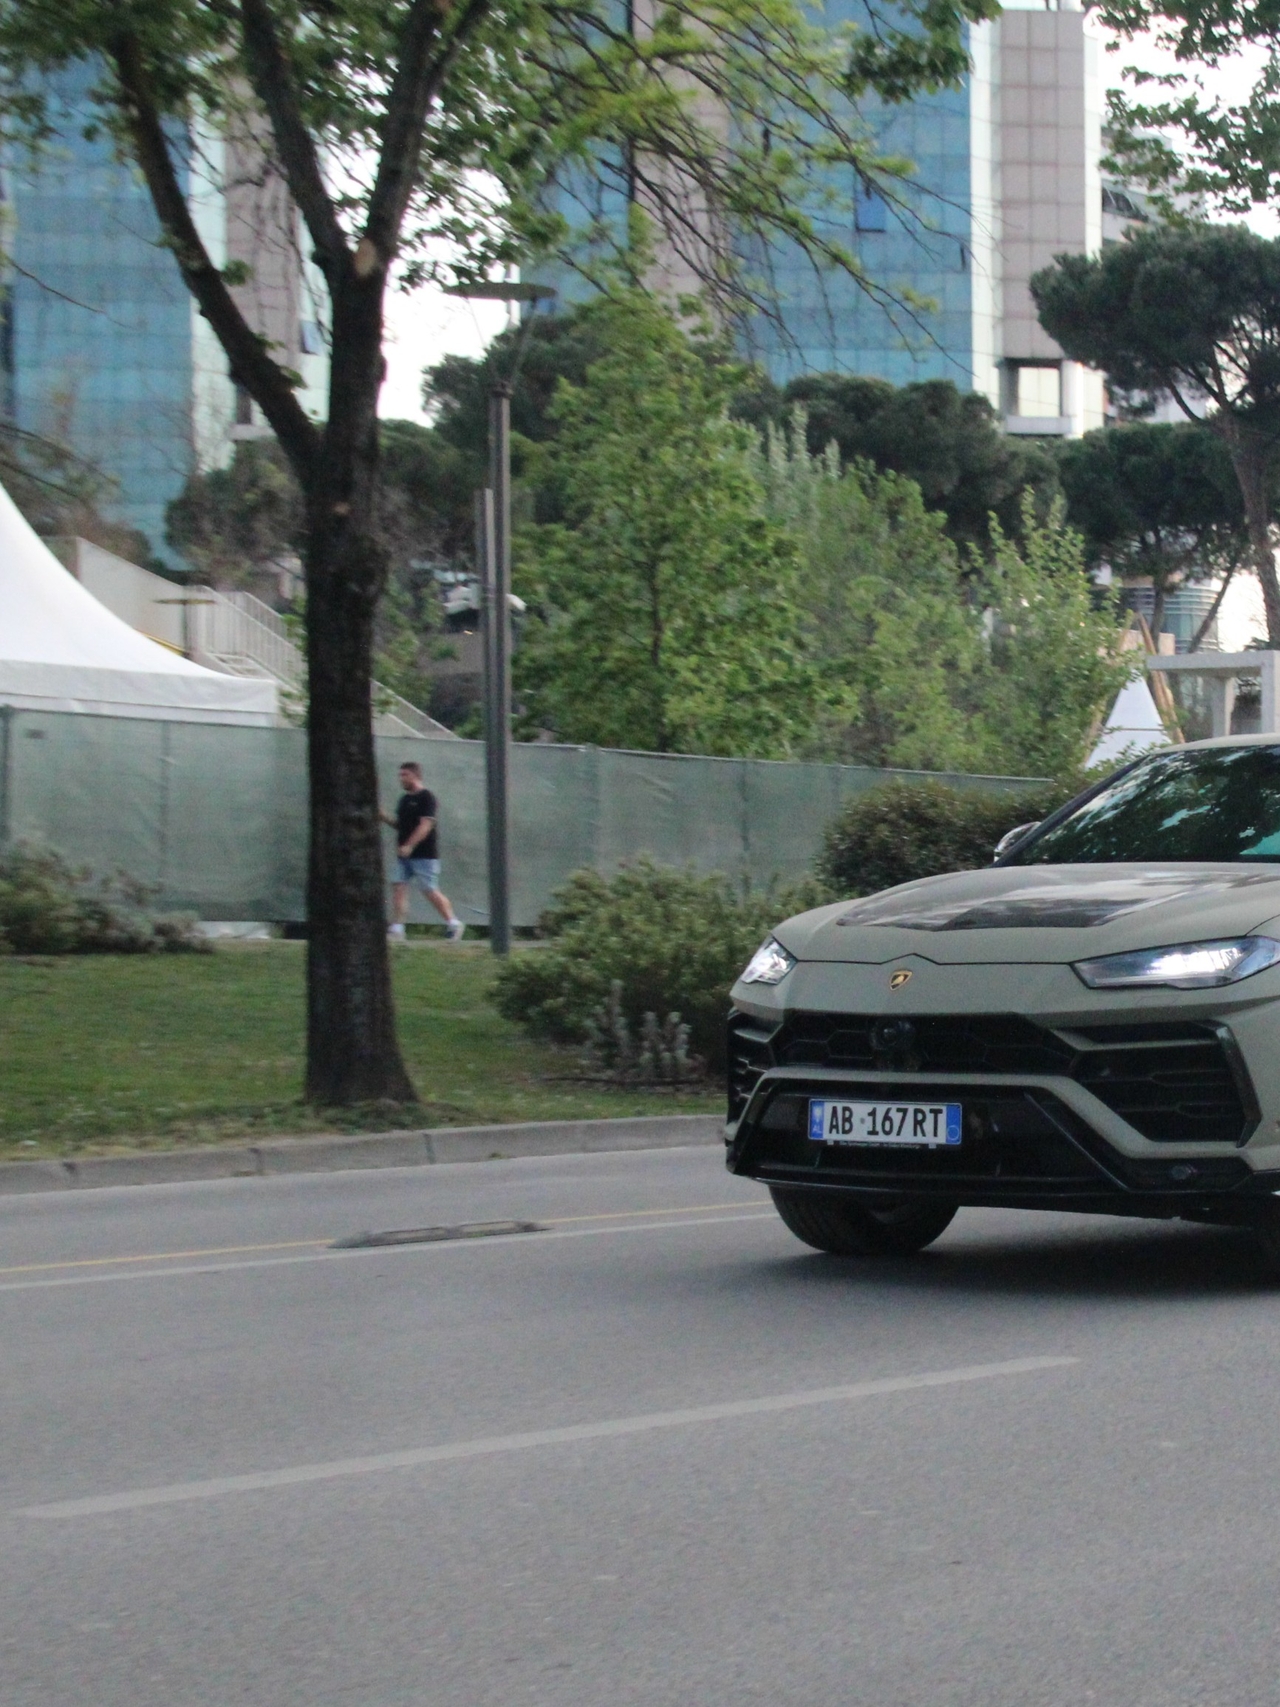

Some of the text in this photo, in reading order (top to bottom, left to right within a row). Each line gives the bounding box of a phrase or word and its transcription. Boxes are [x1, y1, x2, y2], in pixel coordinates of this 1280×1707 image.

[812, 1125, 822, 1134] AL
[829, 1106, 944, 1138] AB 167 RT
